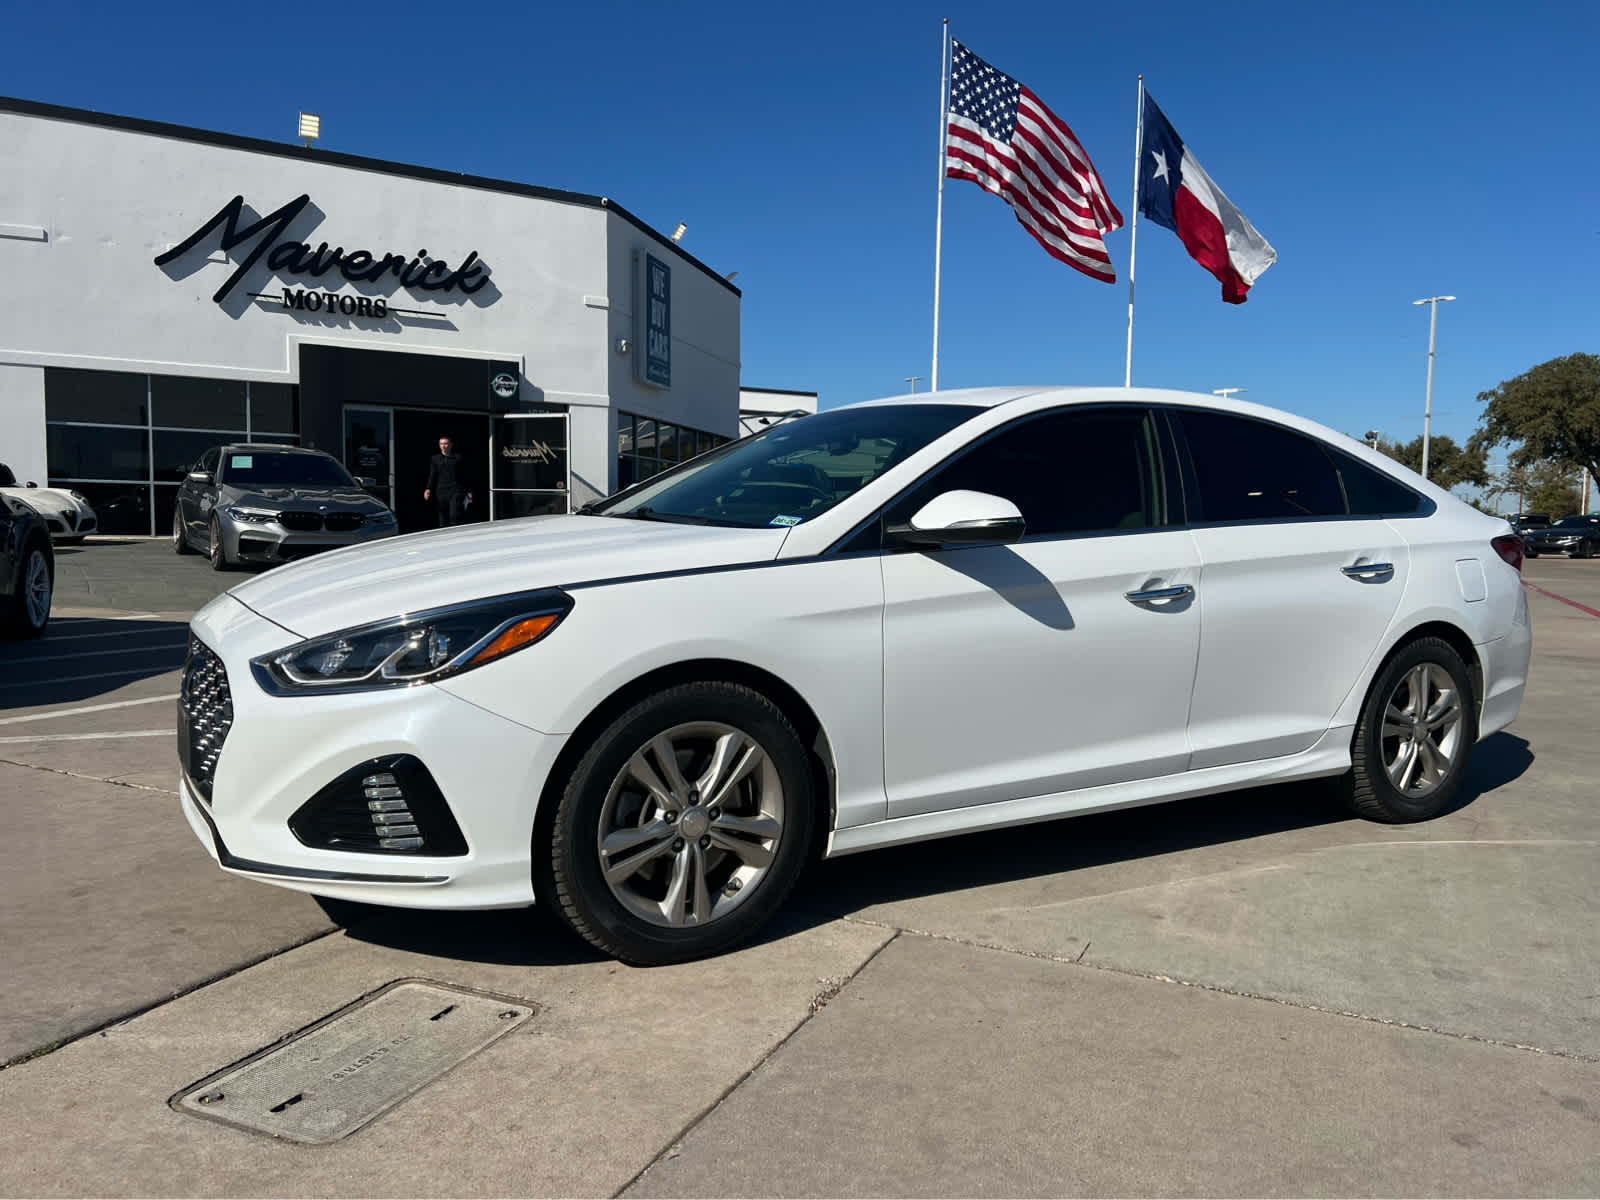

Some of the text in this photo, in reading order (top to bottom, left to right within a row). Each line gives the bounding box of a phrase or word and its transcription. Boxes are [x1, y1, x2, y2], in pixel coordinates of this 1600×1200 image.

[154, 193, 489, 303] Maverick
[652, 264, 665, 298] WE
[281, 287, 388, 319] MOTORS
[651, 298, 666, 330] BUY
[648, 328, 669, 361] CARS
